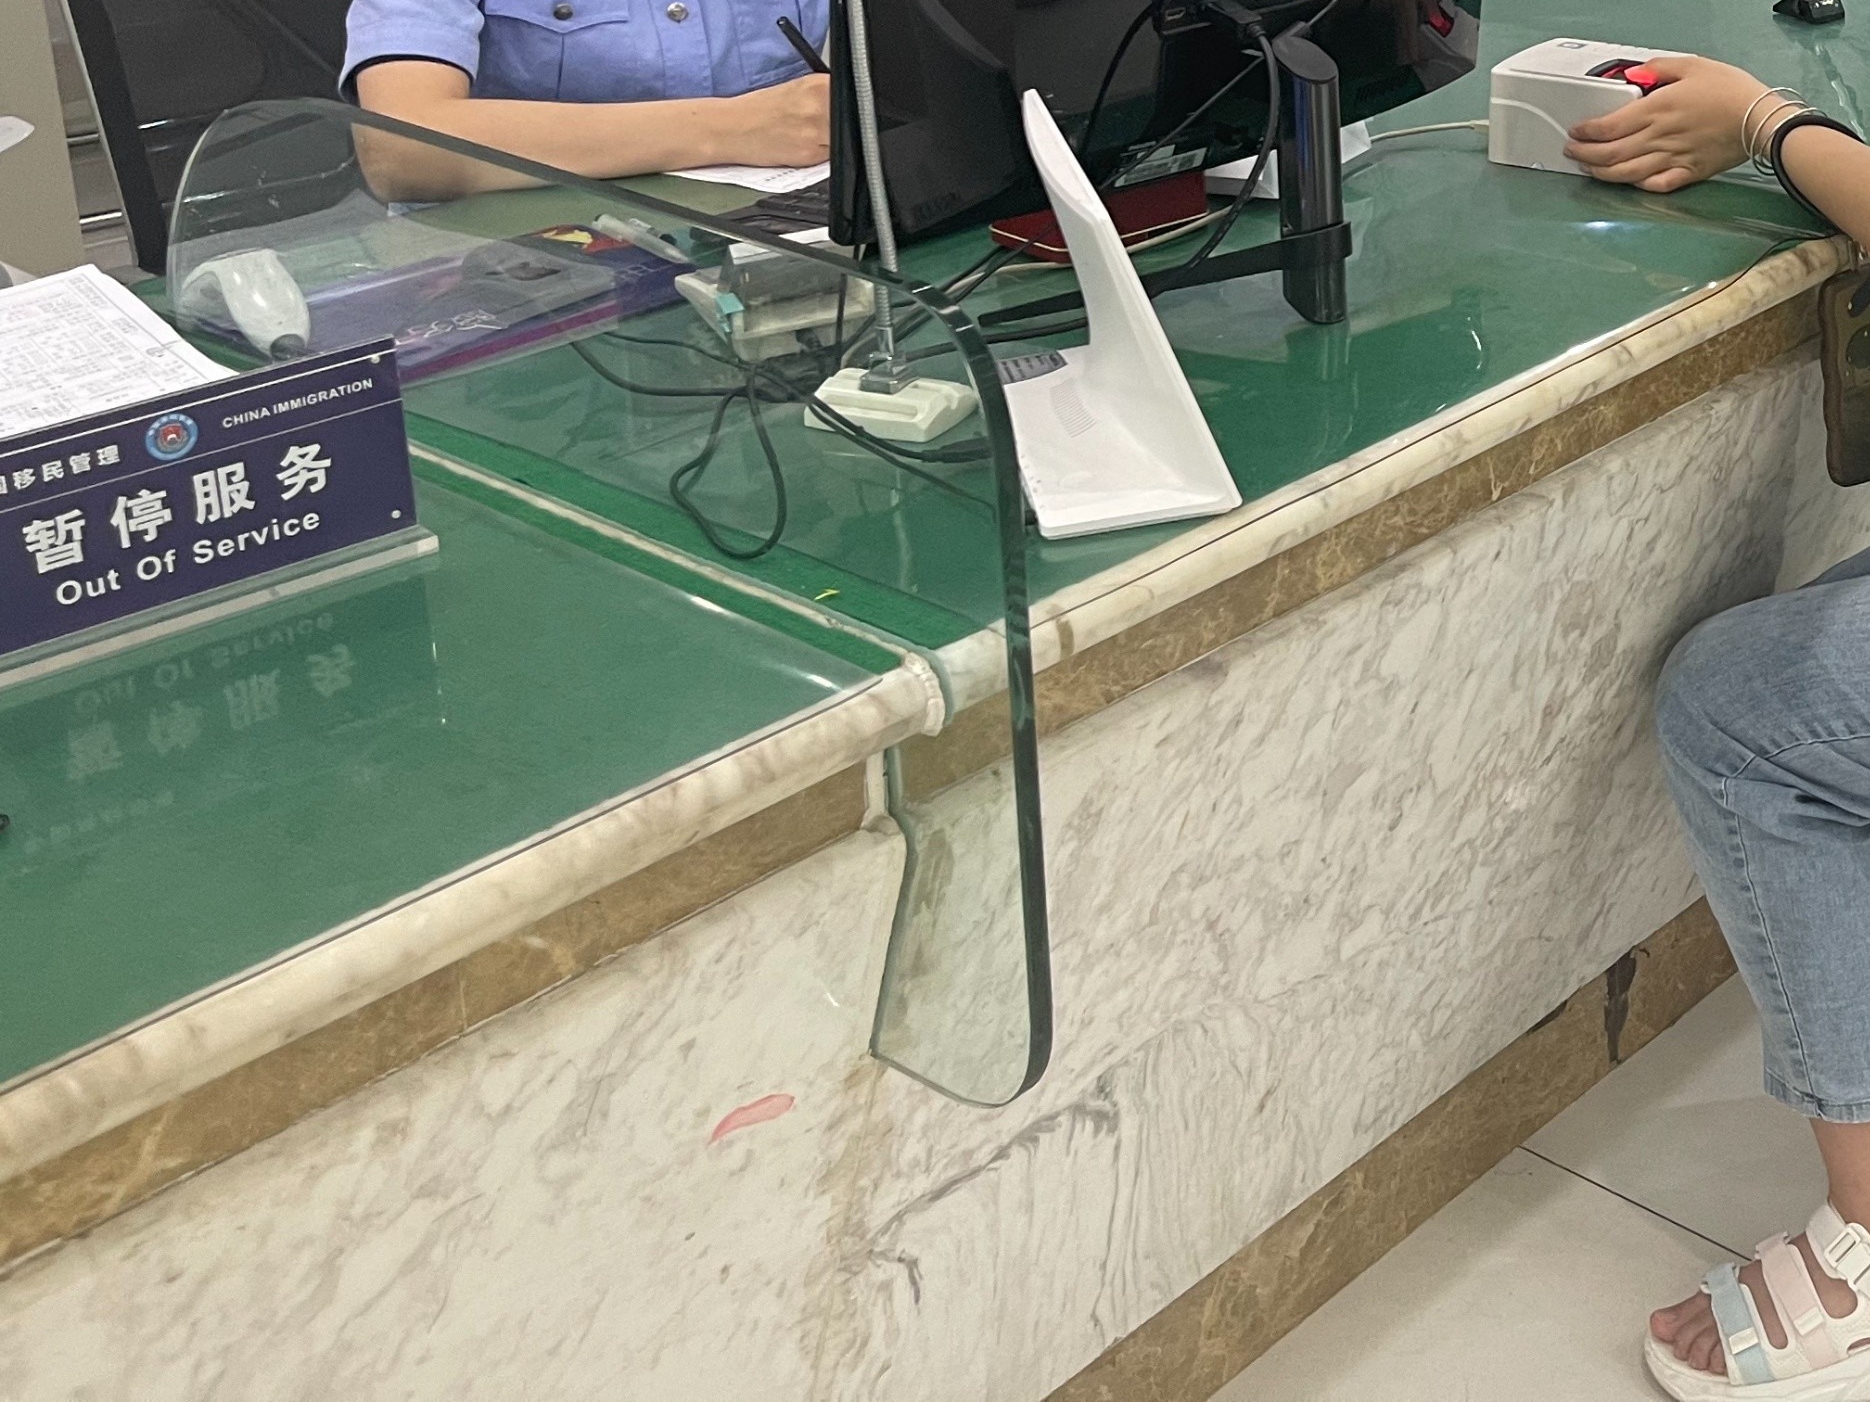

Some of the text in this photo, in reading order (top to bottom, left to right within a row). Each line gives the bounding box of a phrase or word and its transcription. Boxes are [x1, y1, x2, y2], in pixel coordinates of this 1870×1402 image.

[222, 377, 374, 429] CHINA IMMIGRATION
[22, 442, 332, 575] 暂停服务
[55, 511, 321, 607] Out Of Service
